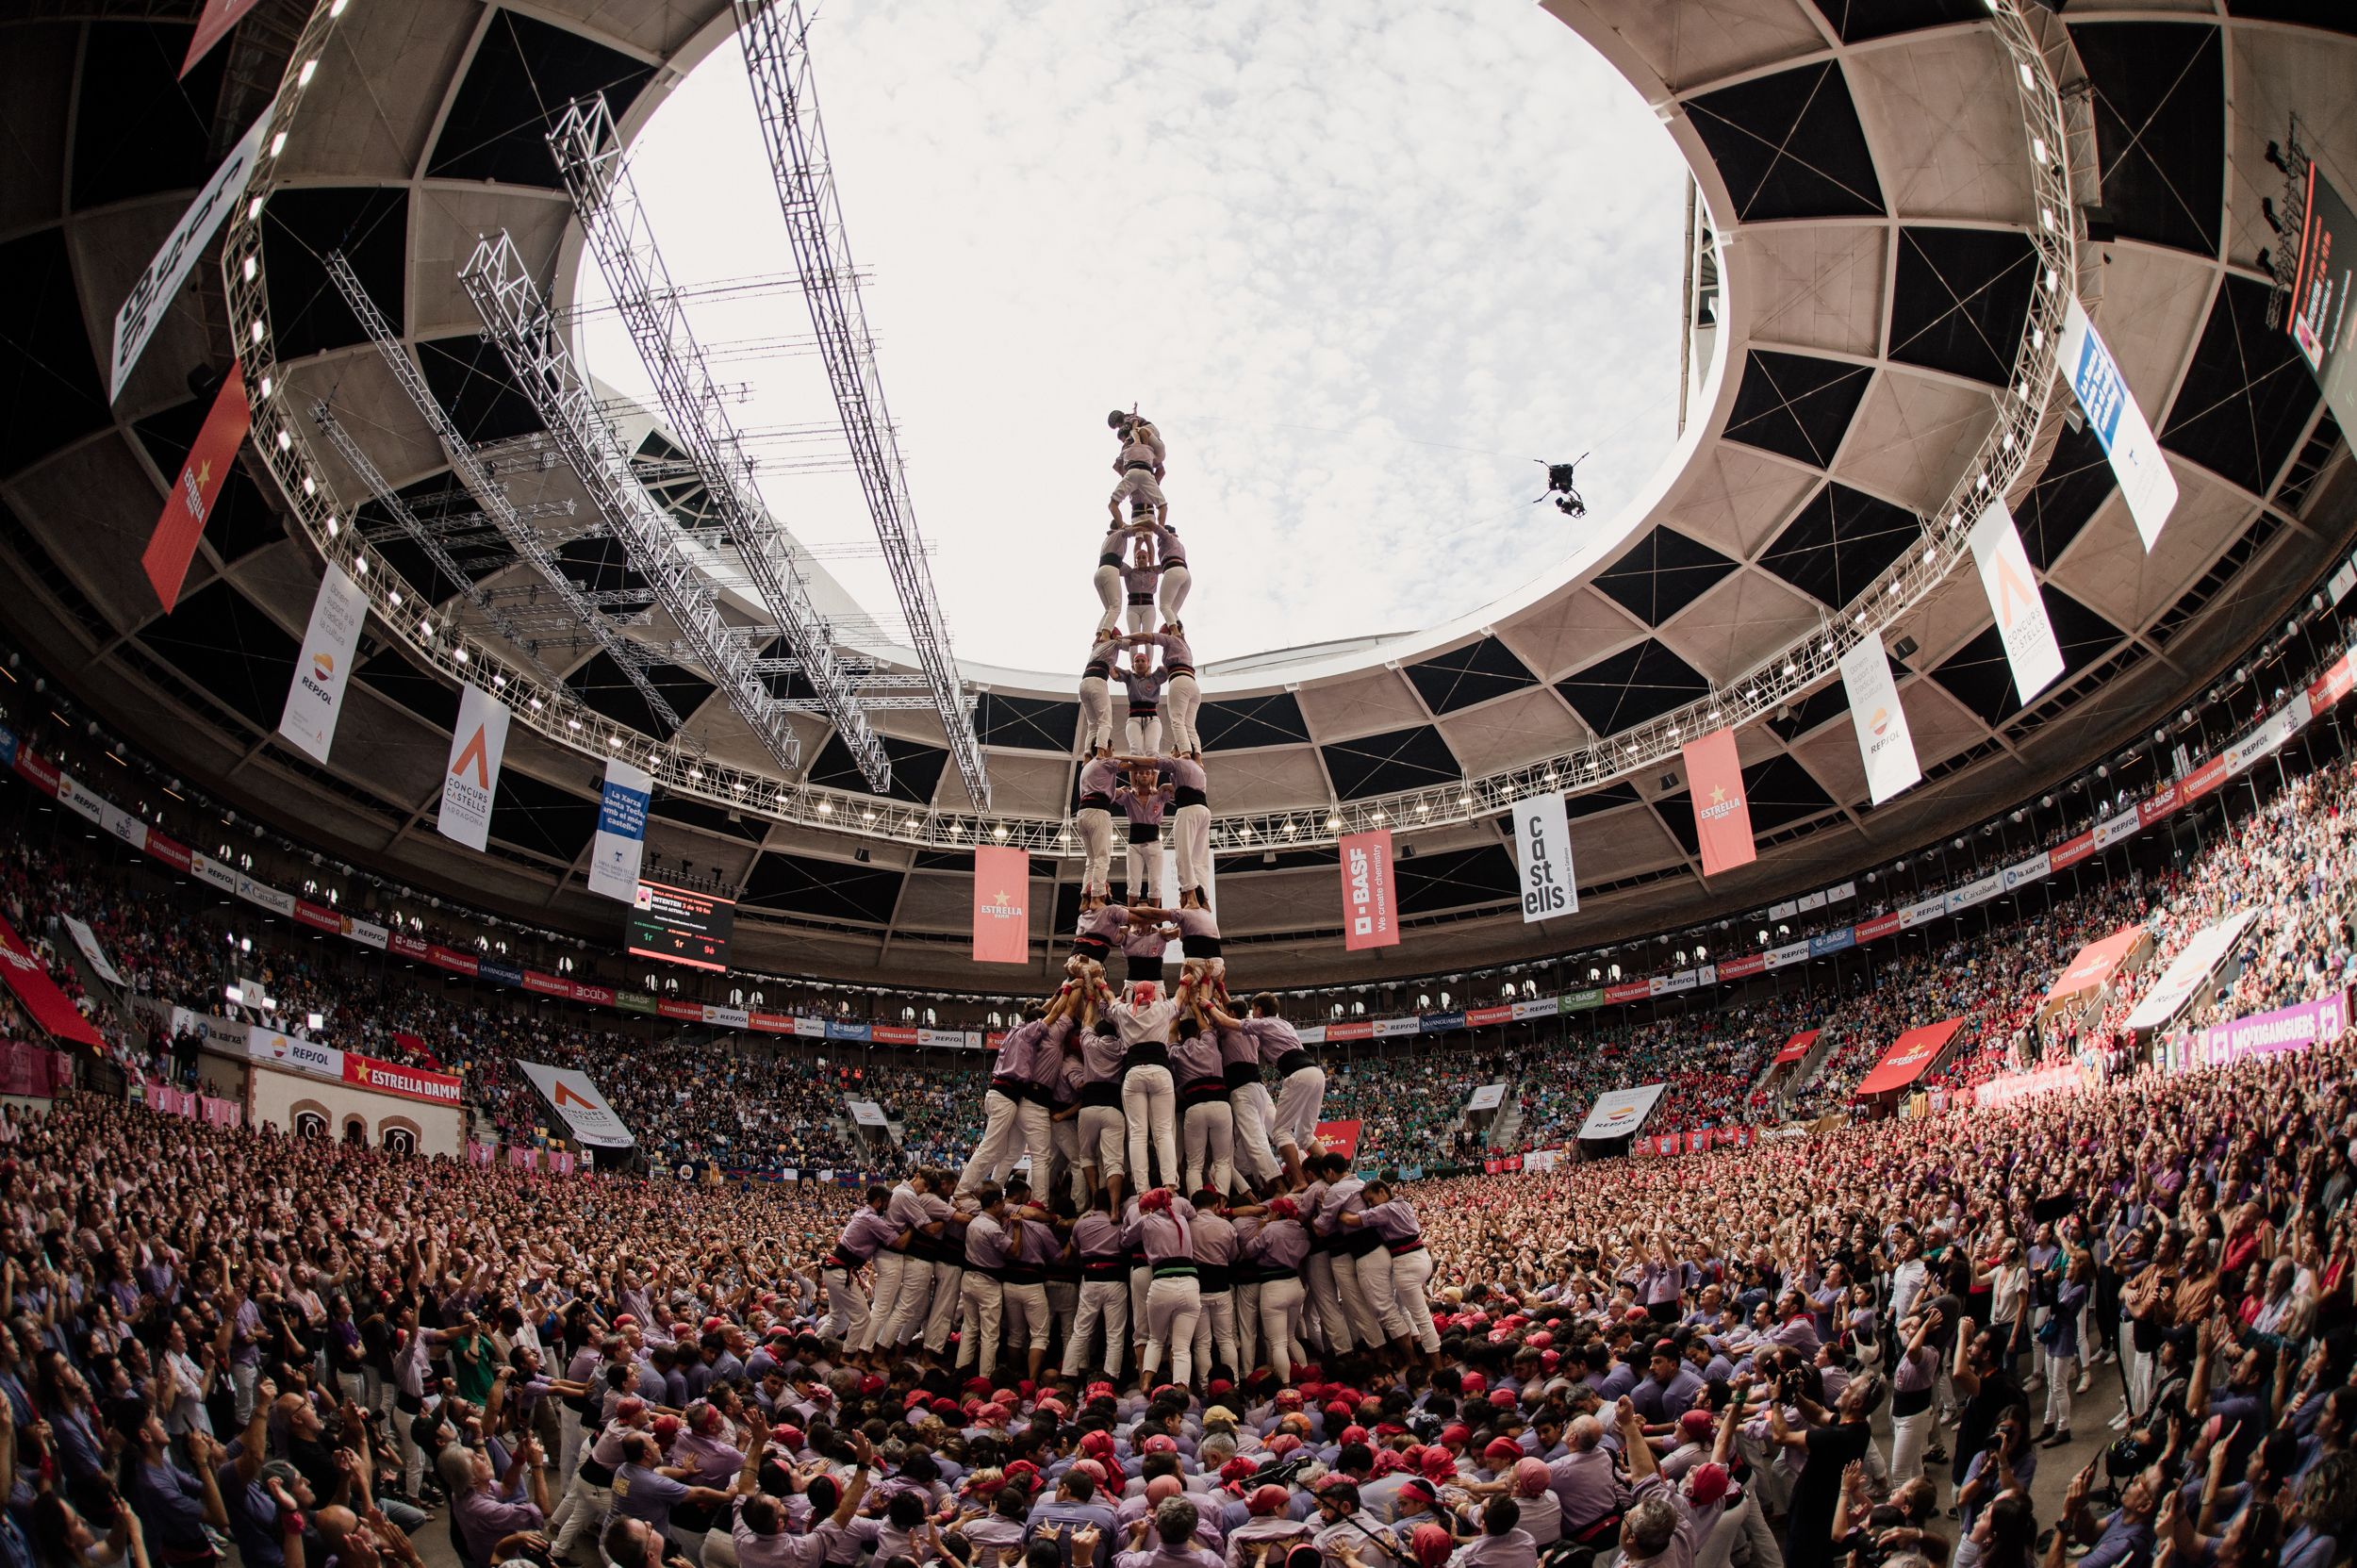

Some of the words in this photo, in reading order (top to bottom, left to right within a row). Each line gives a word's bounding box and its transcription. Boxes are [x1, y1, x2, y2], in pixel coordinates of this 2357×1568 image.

[184, 467, 206, 523] ESTRELLA
[331, 584, 349, 606] Donem
[326, 596, 344, 617] suport
[2008, 606, 2041, 645] CONCURS
[325, 625, 345, 646] cultura
[302, 676, 332, 705] REPSOL
[1871, 730, 1901, 753] REPSOL
[2241, 734, 2268, 758] REPSOL
[448, 777, 487, 803] CONCURS
[2154, 787, 2175, 808] BASF
[74, 793, 100, 816] REPSOL
[446, 788, 486, 813] CASTELLS
[612, 790, 620, 800] La
[621, 793, 641, 808] Xarxa
[604, 797, 624, 810] Santa
[626, 804, 646, 818] Tecla,
[1700, 798, 1740, 819] ESTRELLA
[603, 806, 618, 817] amb
[619, 812, 626, 820] el
[627, 815, 643, 826] món
[607, 817, 637, 833] casteller
[2111, 815, 2138, 834] REPSOL
[2057, 846, 2080, 862] ESTRELLA
[1373, 844, 1384, 885] chemistry
[207, 867, 234, 884] REPSOL
[1350, 848, 1370, 904] BASF
[2017, 870, 2024, 879] la
[253, 887, 288, 910] CaixaBank
[1963, 881, 1999, 901] CaixaBank
[652, 896, 682, 907] INTENTEN
[1376, 887, 1385, 915] create
[1525, 885, 1565, 915] ells
[981, 905, 1022, 916] ESTRELLA
[1916, 902, 1944, 917] REPSOL
[1378, 916, 1387, 933] We
[1861, 924, 1885, 936] ESTRELLA
[357, 928, 387, 942] REPSOL
[644, 933, 652, 942] 1r
[1826, 930, 1848, 944] BASF
[405, 939, 427, 951] BASF
[674, 939, 684, 949] 1r
[1781, 947, 1808, 960] REPSOL
[1725, 965, 1748, 974] ESTRELLA
[531, 980, 552, 988] ESTRELLA
[1667, 976, 1695, 987] REPSOL
[576, 986, 602, 999] 3cat
[629, 995, 650, 1004] BASF
[1575, 992, 1597, 1001] BASF
[1611, 990, 1634, 999] ESTRELLA
[664, 1005, 686, 1014] ESTRELLA
[1529, 1003, 1558, 1013] REPSOL
[719, 1014, 747, 1023] REPSOL
[755, 1019, 778, 1028] ESTRELLA
[1474, 1013, 1496, 1021] ESTRELLA
[209, 1028, 216, 1038] la
[844, 1025, 865, 1033] BASF
[1390, 1022, 1419, 1031] REPSOL
[292, 1046, 329, 1065] REPSOL
[1886, 1049, 1930, 1065] ESTRELLA
[371, 1069, 422, 1094] ESTRELLA
[424, 1082, 460, 1100] DAMM
[1594, 1117, 1636, 1128] REPSOL
